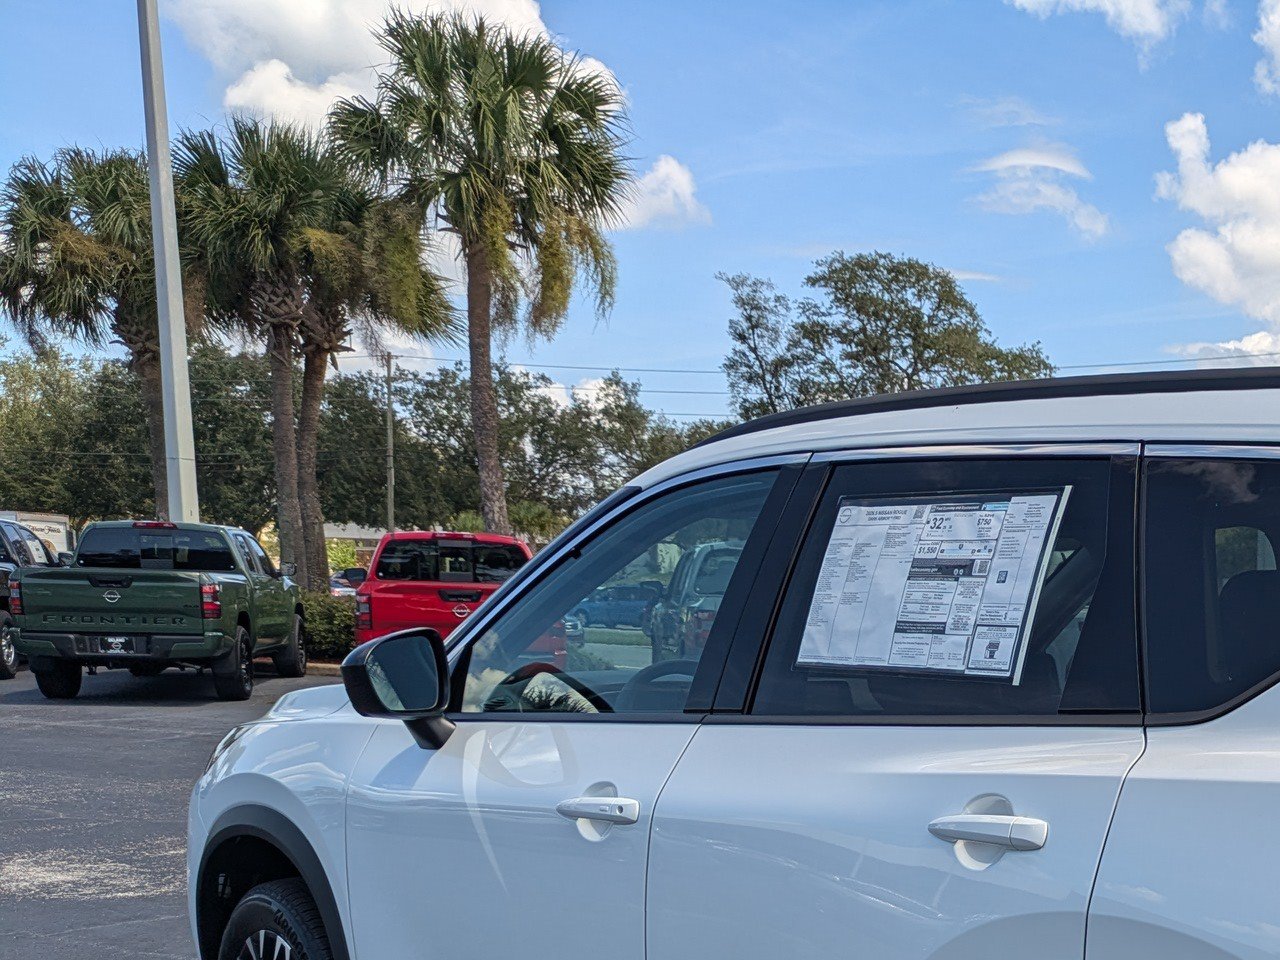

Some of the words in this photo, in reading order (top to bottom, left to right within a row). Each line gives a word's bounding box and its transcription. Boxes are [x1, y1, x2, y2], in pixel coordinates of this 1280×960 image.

[930, 517, 945, 530] 32
[977, 518, 992, 526] $750
[918, 546, 938, 555] $1,550
[42, 614, 188, 626] FRONTIER
